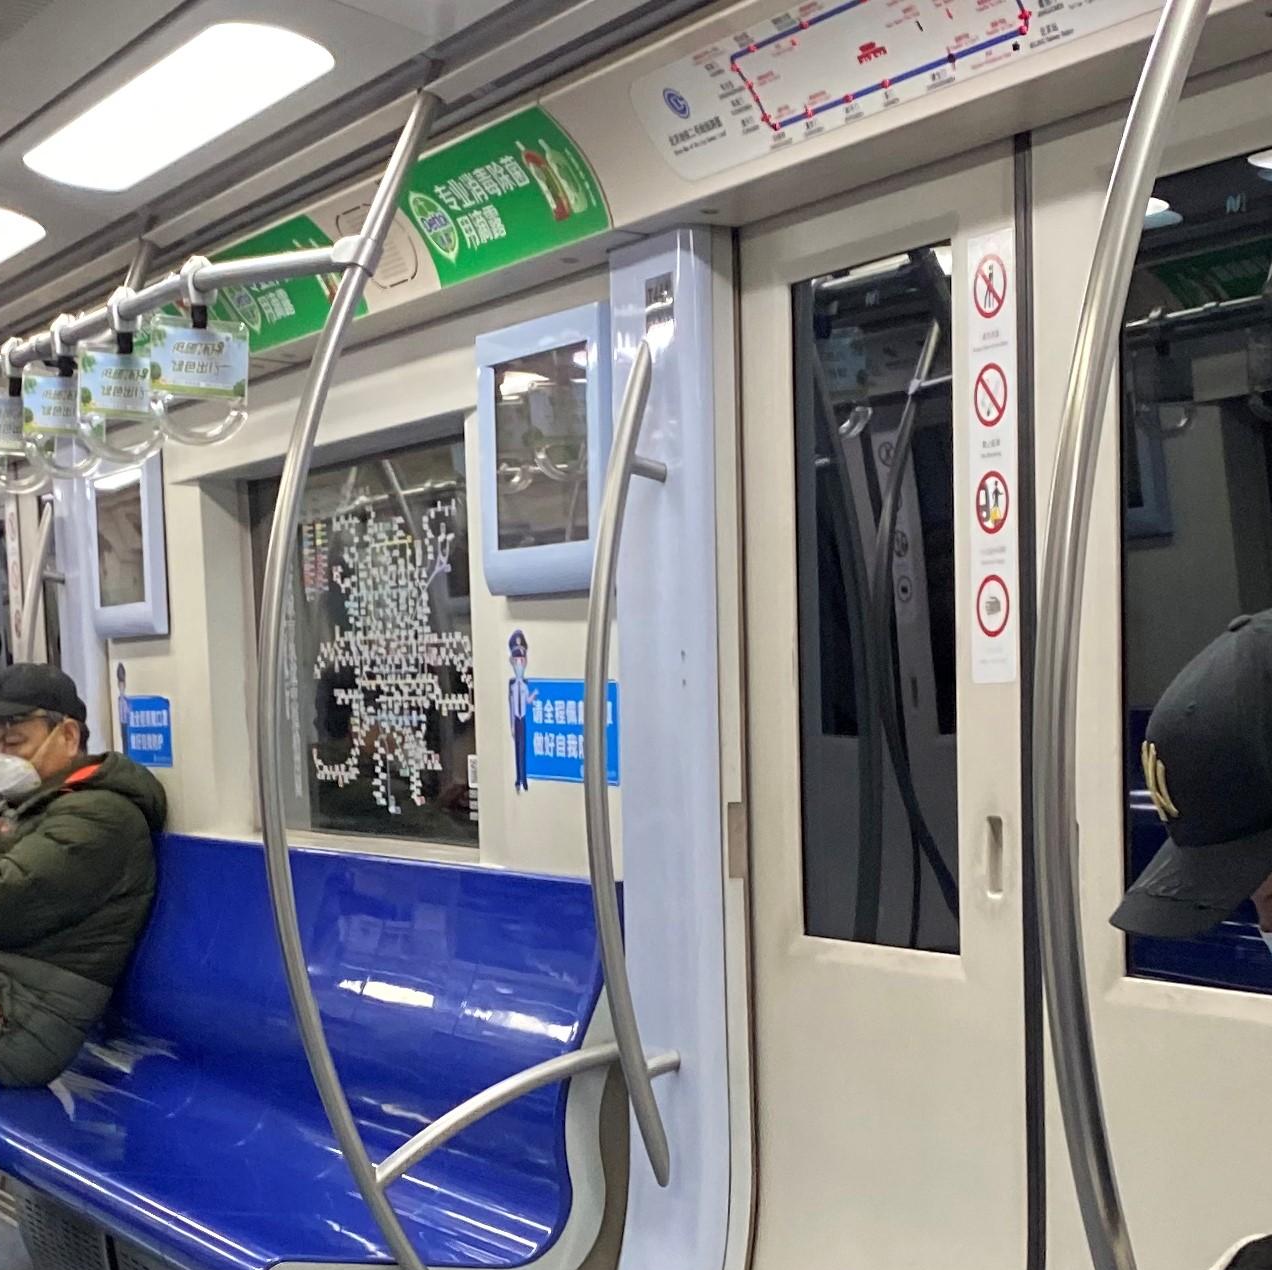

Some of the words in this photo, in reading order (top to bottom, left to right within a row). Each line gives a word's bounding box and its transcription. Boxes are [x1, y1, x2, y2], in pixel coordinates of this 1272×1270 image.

[433, 155, 530, 212] 专业消毒除菌
